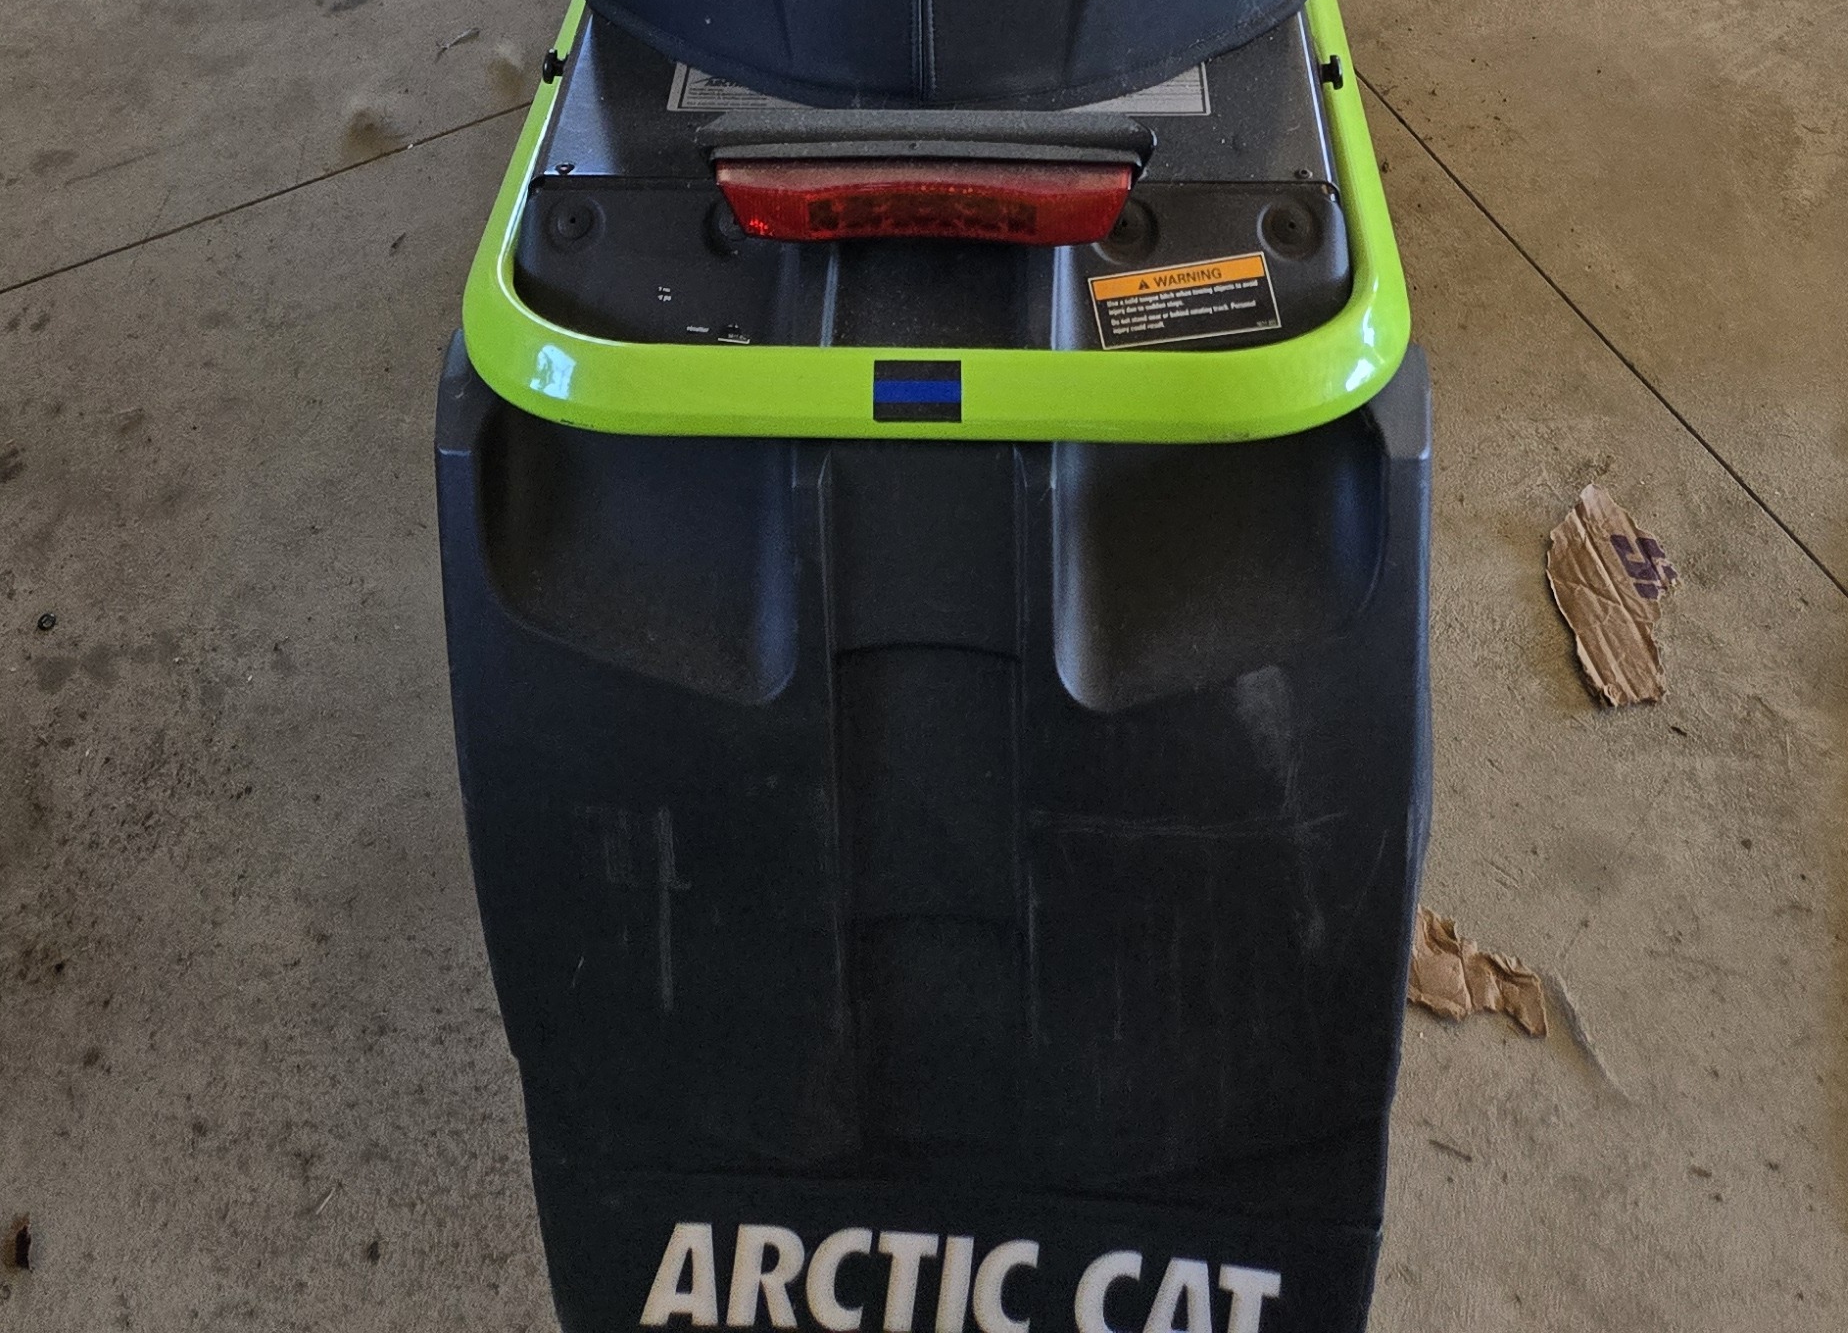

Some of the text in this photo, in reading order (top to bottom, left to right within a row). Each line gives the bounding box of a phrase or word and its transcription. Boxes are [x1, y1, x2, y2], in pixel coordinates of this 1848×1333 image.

[1153, 267, 1222, 288] WARNING
[638, 1221, 1283, 1333] ARCTIC CAT
